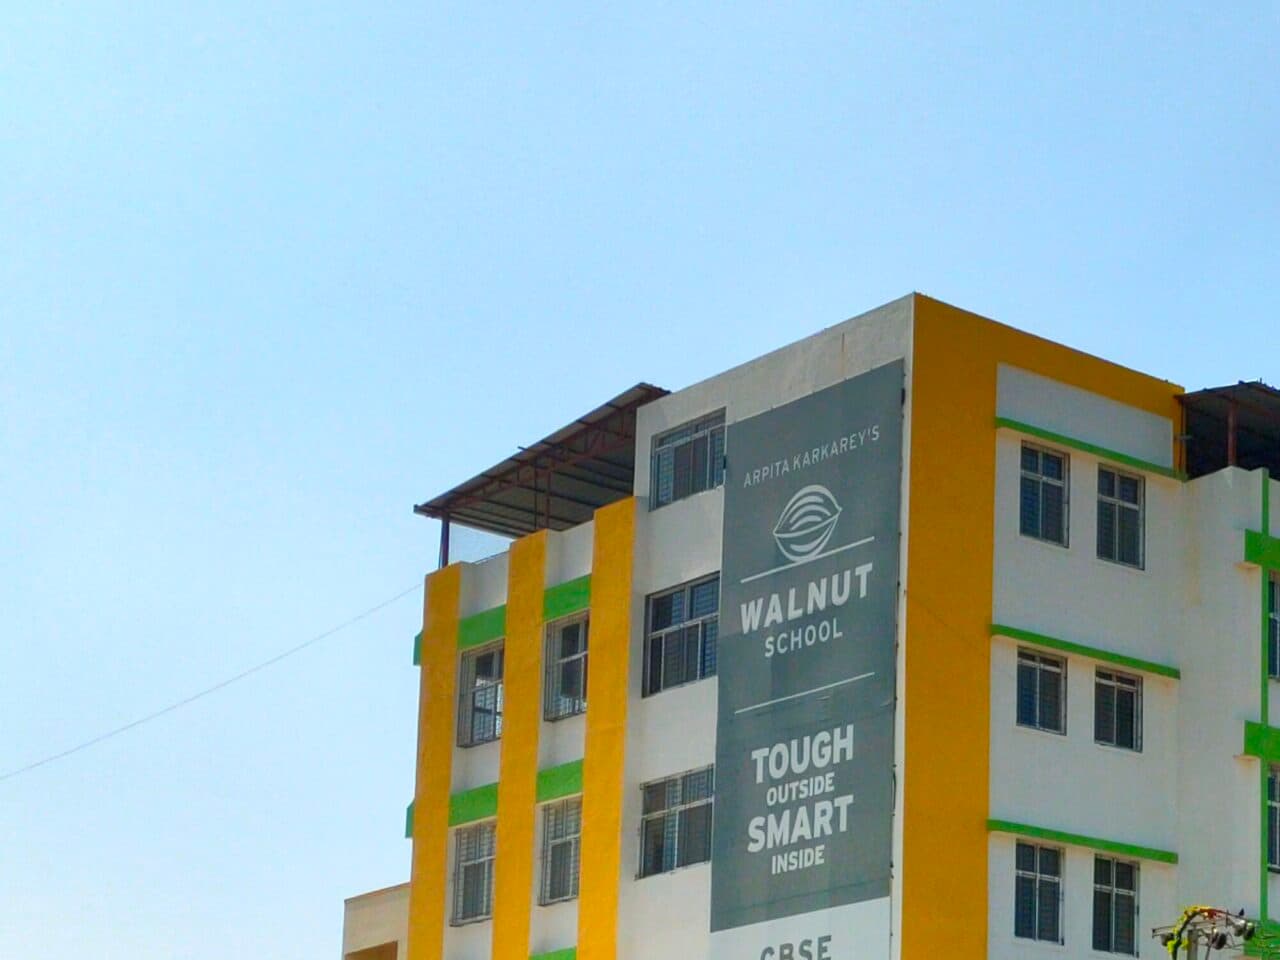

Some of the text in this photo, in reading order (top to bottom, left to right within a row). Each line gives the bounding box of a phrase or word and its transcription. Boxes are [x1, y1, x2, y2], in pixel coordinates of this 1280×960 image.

[743, 425, 881, 489] ARPITA KARKAREY'S
[740, 562, 874, 635] WALNUT
[764, 617, 844, 658] SCHOOL
[751, 724, 854, 784] TOUGH
[766, 771, 835, 806] OUTSIDE
[746, 794, 854, 853] SMART
[771, 844, 825, 876] INSIDE
